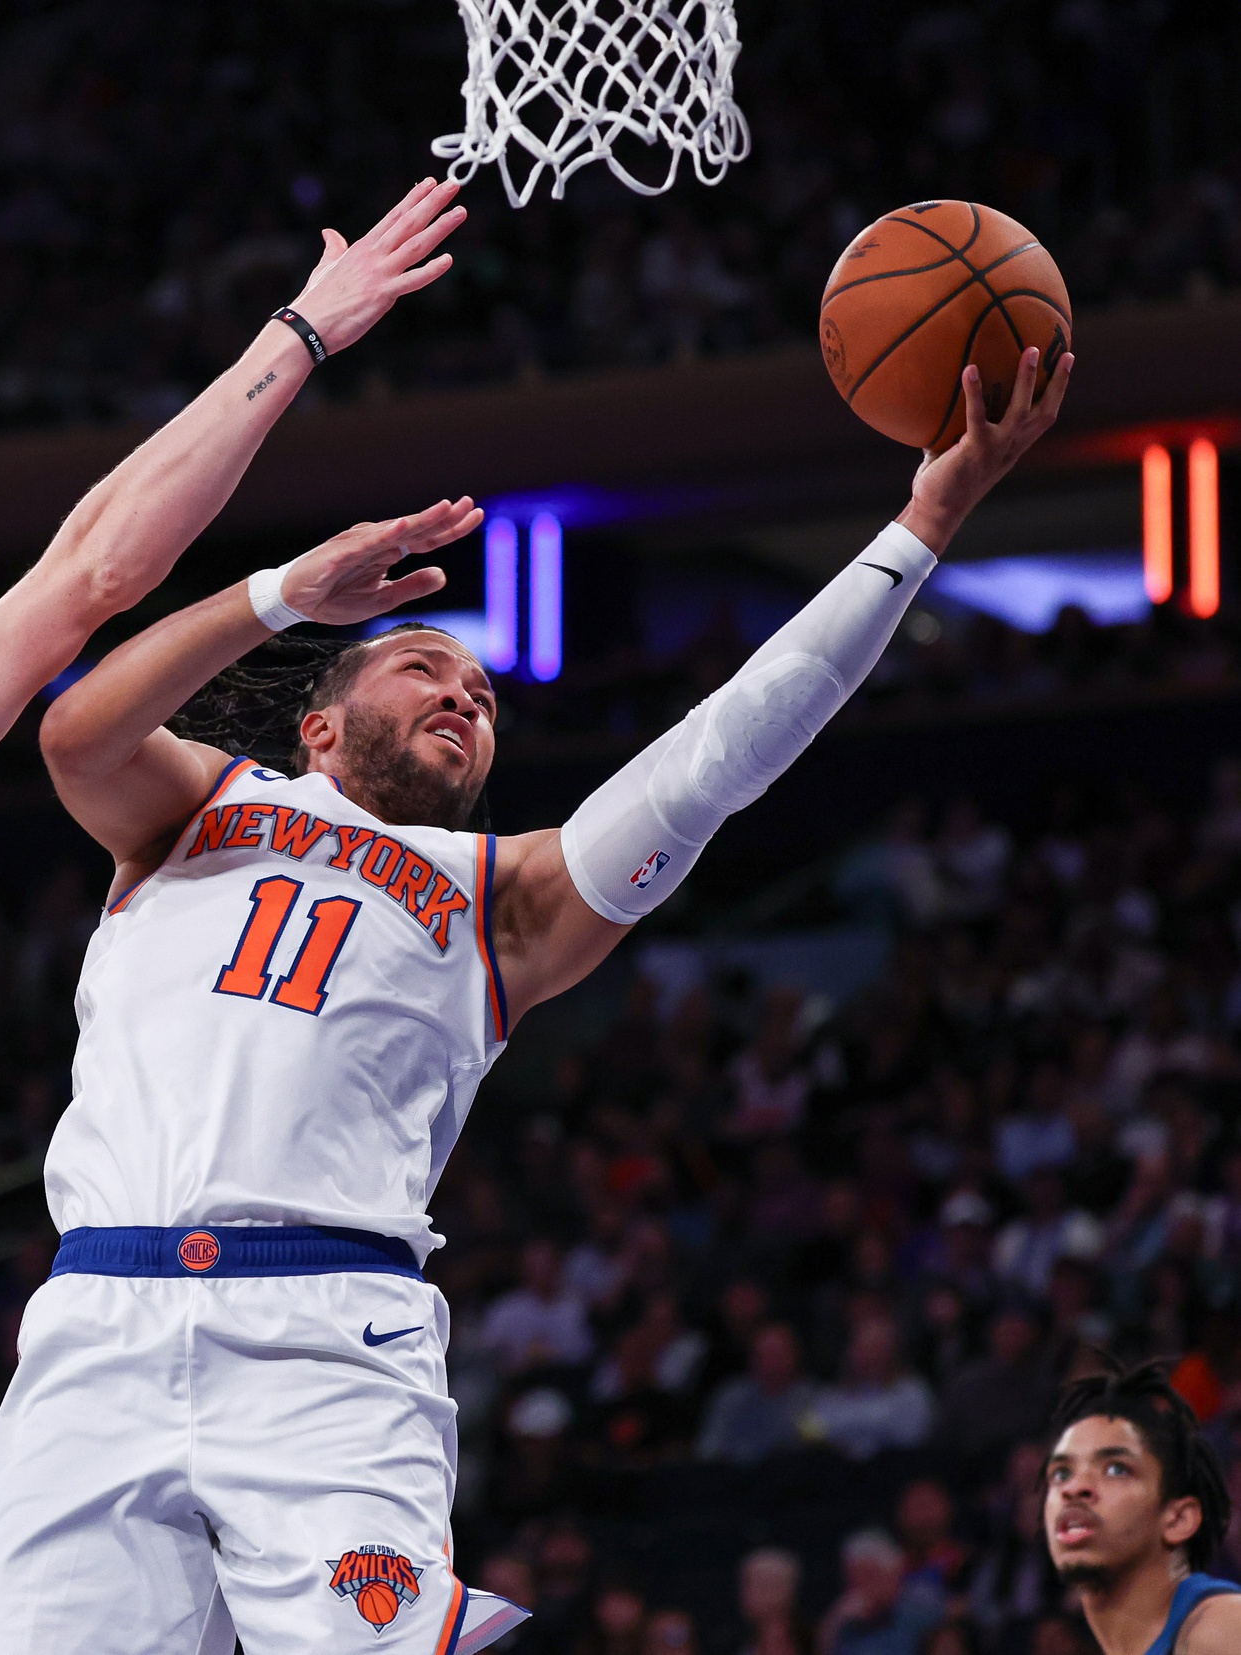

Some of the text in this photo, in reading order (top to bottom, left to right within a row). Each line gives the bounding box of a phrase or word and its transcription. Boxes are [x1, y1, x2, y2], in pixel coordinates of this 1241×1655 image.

[184, 803, 472, 957] NEW YORK
[212, 874, 362, 1017] 11
[183, 1242, 215, 1260] KNICKS
[329, 1550, 420, 1597] KNICKS
[358, 1544, 396, 1557] NEW YORK
